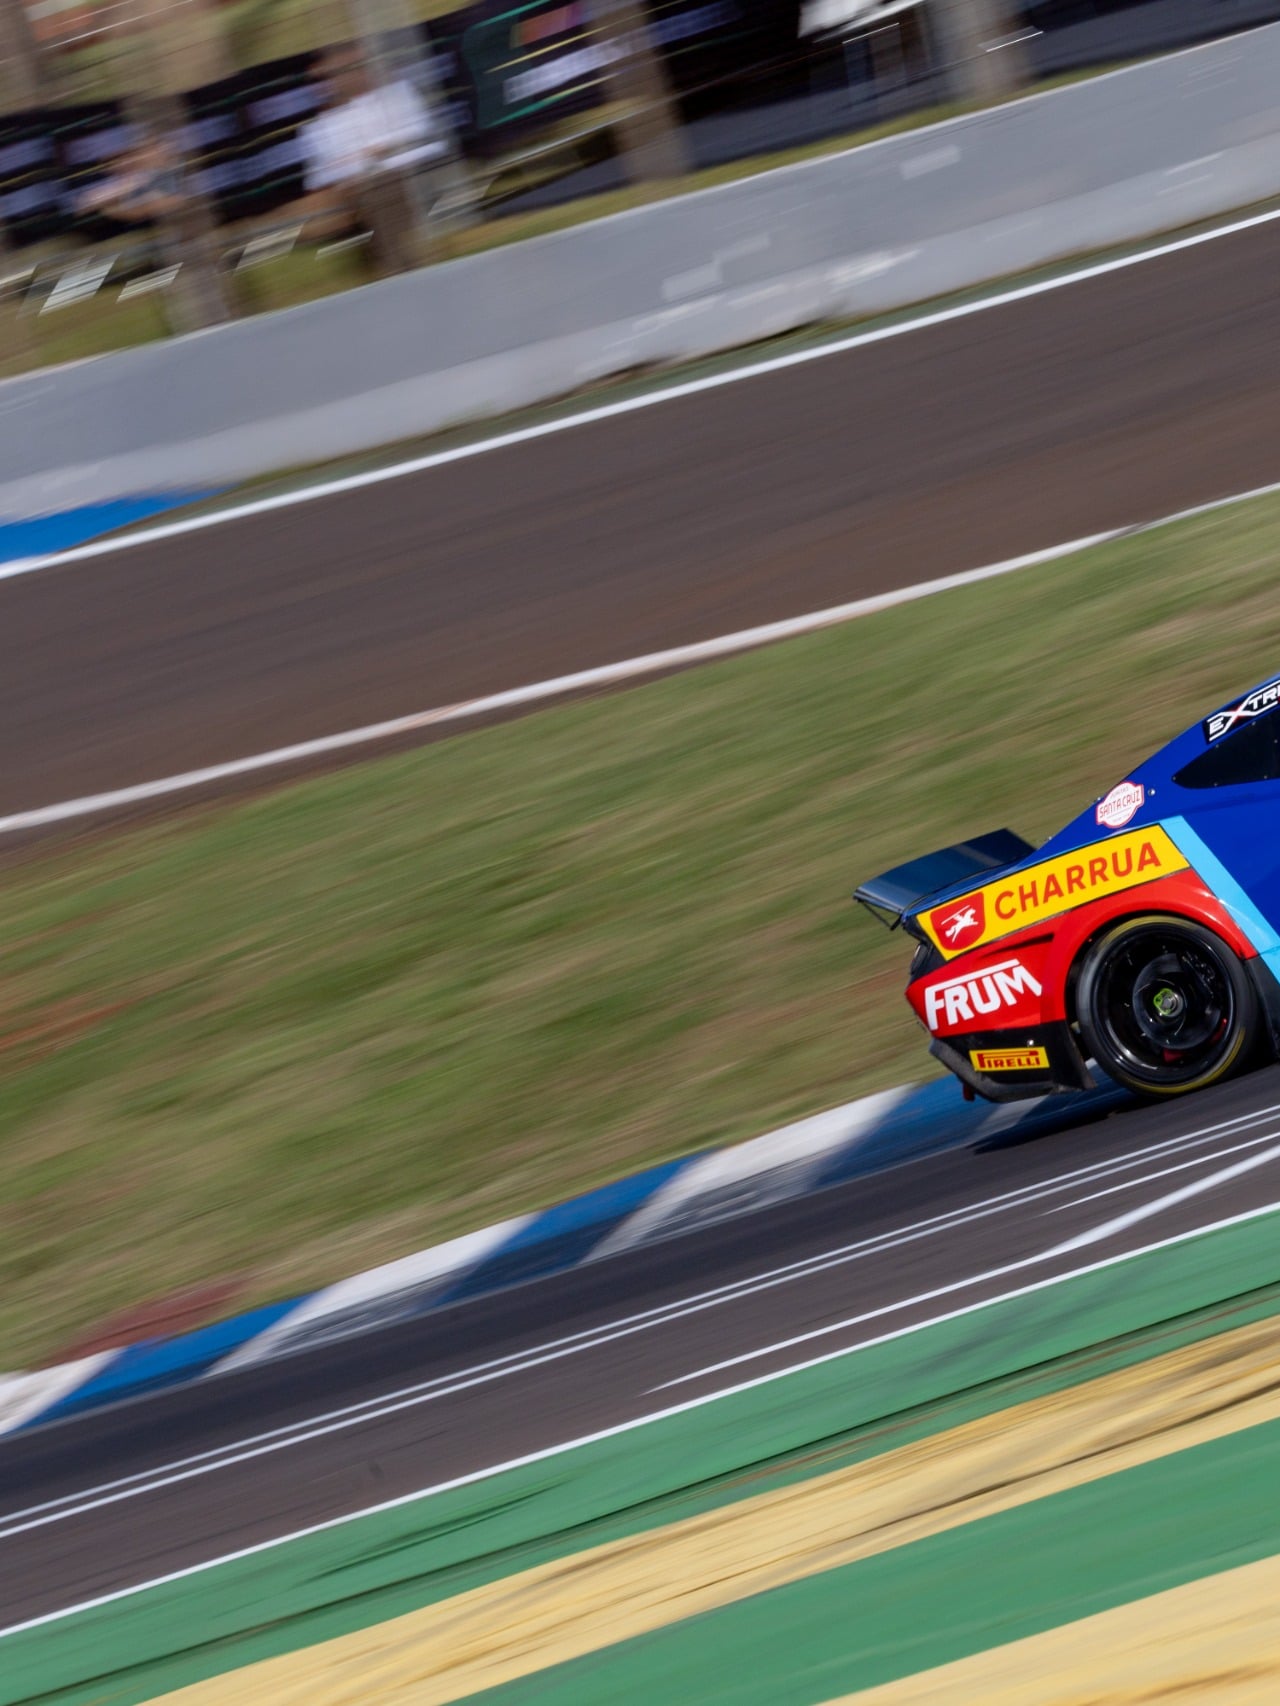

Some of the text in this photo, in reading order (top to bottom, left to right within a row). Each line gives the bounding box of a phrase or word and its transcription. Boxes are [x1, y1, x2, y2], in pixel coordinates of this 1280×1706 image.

[1099, 799, 1122, 819] SANTA
[1122, 790, 1141, 807] CRUZ
[995, 842, 1162, 920] CHARRUA
[925, 958, 1042, 1031] FRUM
[977, 1050, 1040, 1069] PIRELLI
